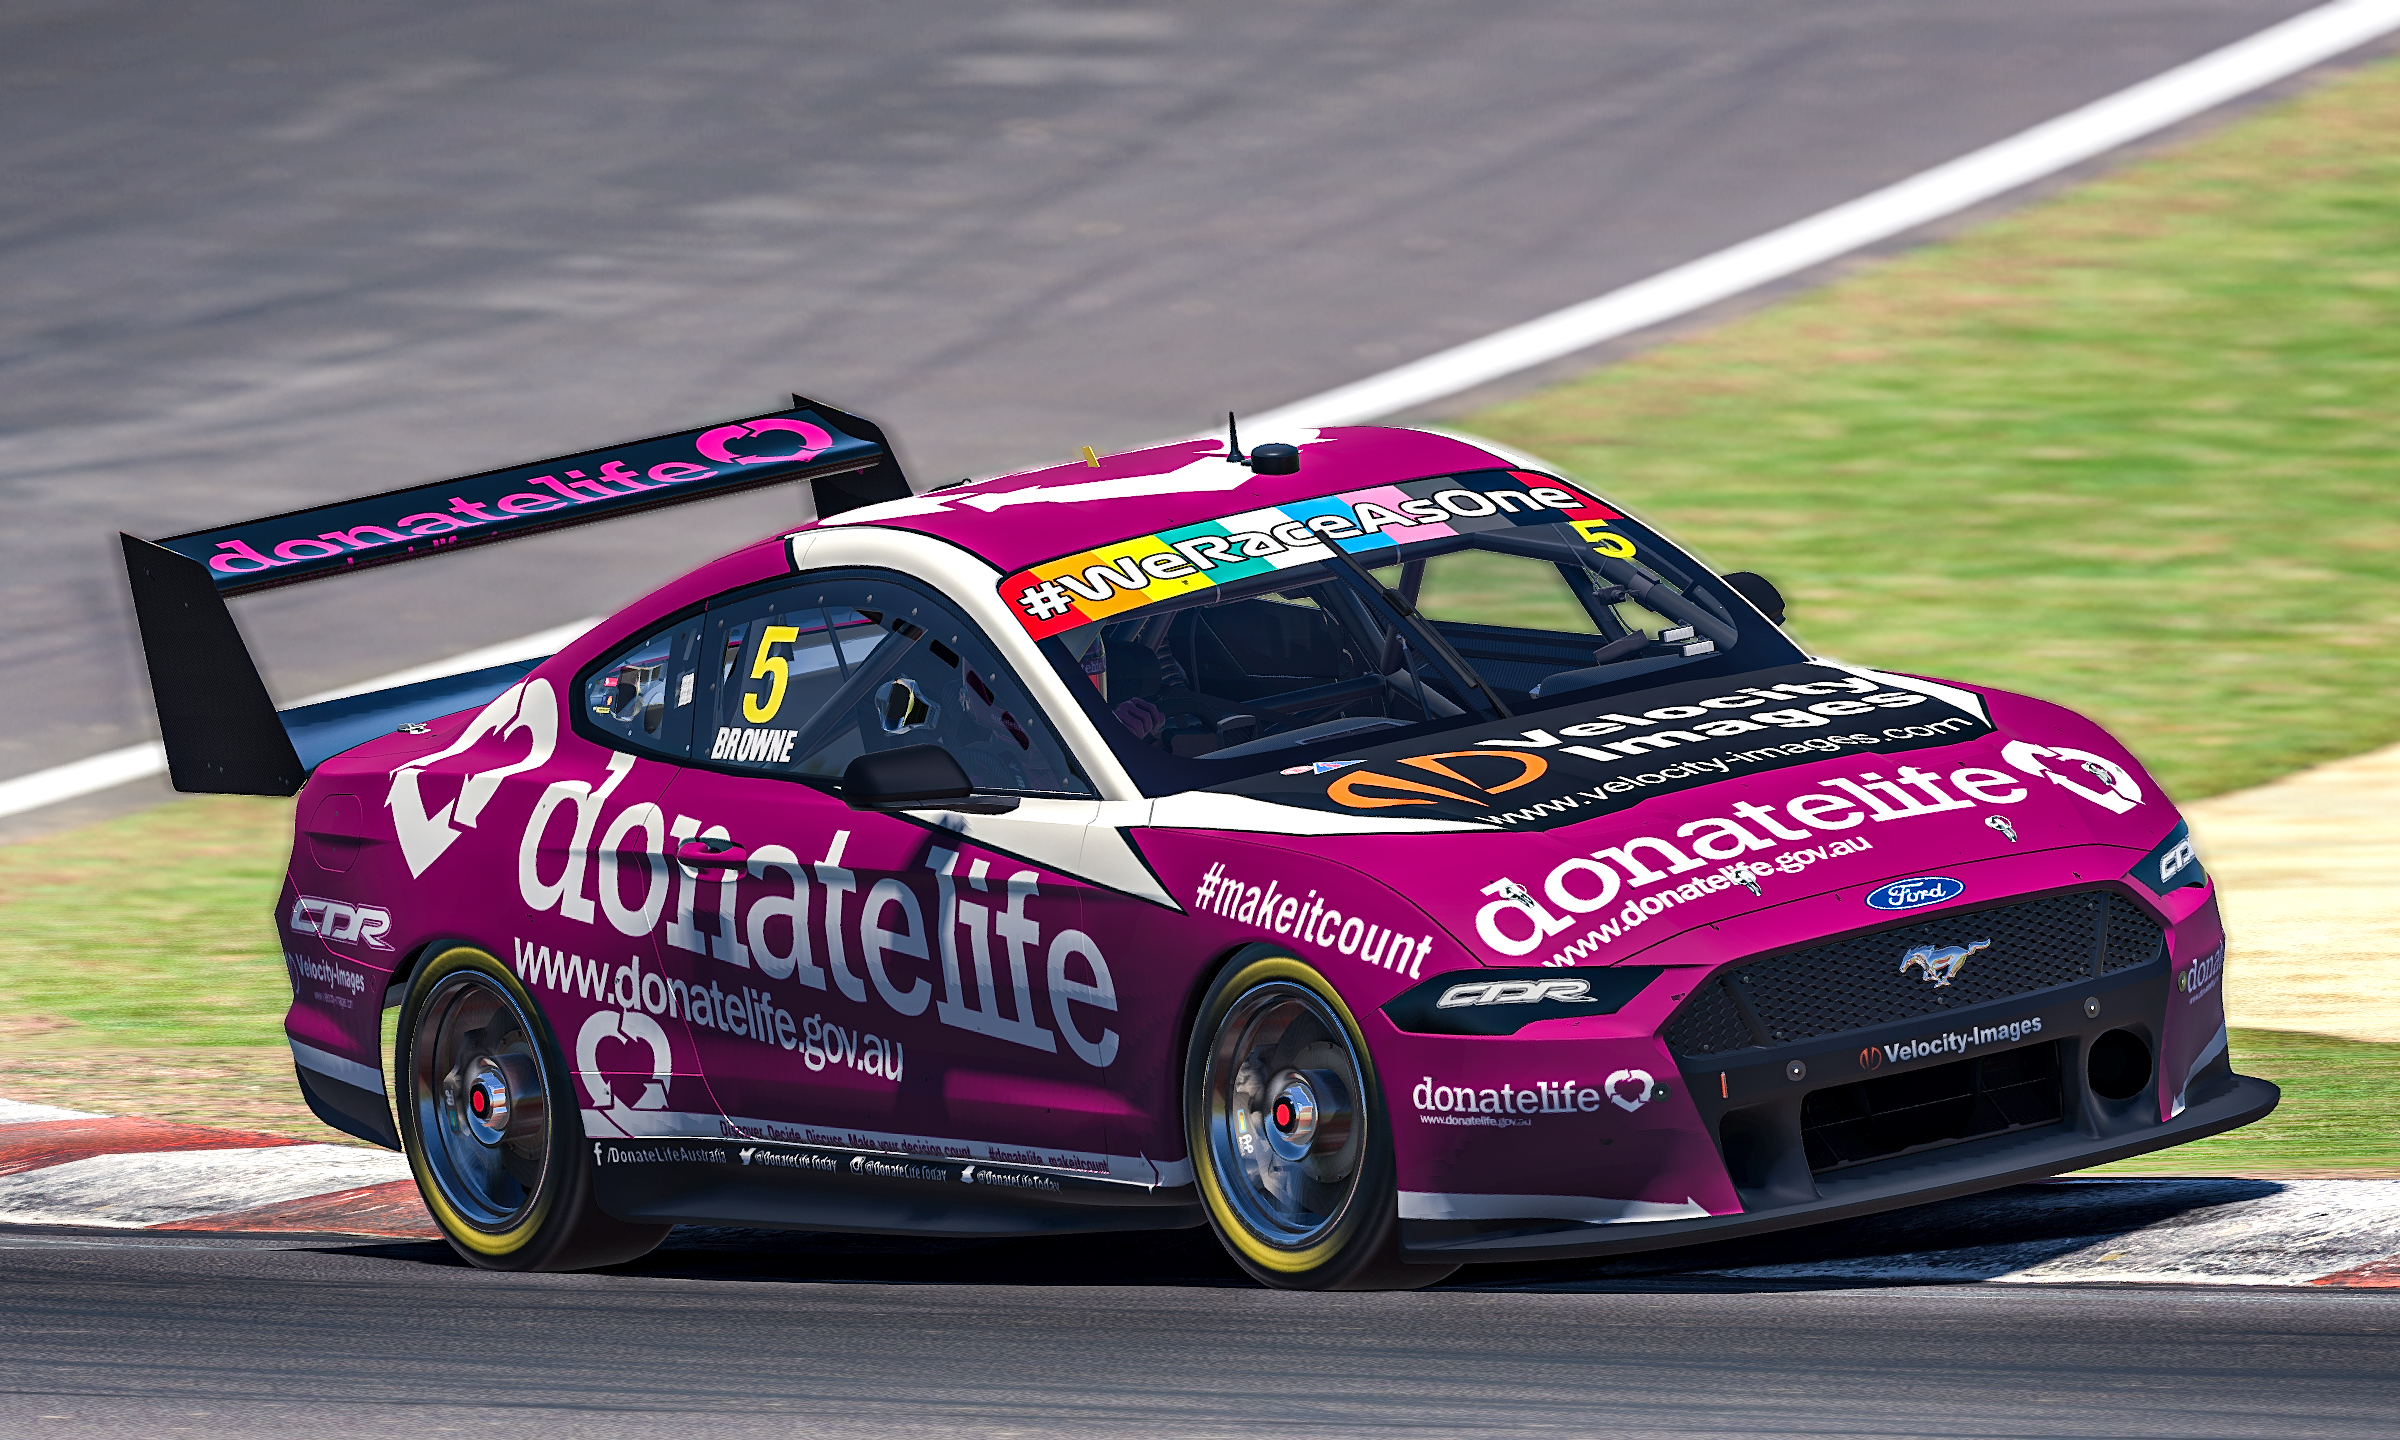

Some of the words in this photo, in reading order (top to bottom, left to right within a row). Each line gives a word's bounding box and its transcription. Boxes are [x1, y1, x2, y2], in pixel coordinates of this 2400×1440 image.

[208, 460, 718, 574] donatelife
[1018, 483, 1584, 623] #WeRaceAsOne
[1565, 519, 1636, 559] 5
[742, 625, 800, 727] 5
[1474, 674, 1880, 748] Velocity
[711, 726, 799, 765] BROWNE
[1558, 690, 1929, 763] Images
[1475, 759, 2029, 958] donatelife
[1888, 882, 1947, 906] Ford
[290, 894, 396, 952] CDR
[519, 752, 1120, 1068] donatelife
[1196, 861, 1433, 980] #makeitcount
[295, 953, 365, 996] Velocity-Images
[513, 937, 904, 1082] www.donatelife.gov.au
[1436, 978, 1598, 1010] CDR
[1884, 1016, 2042, 1064] Velocity-Images
[1413, 1076, 1600, 1114] donatelife
